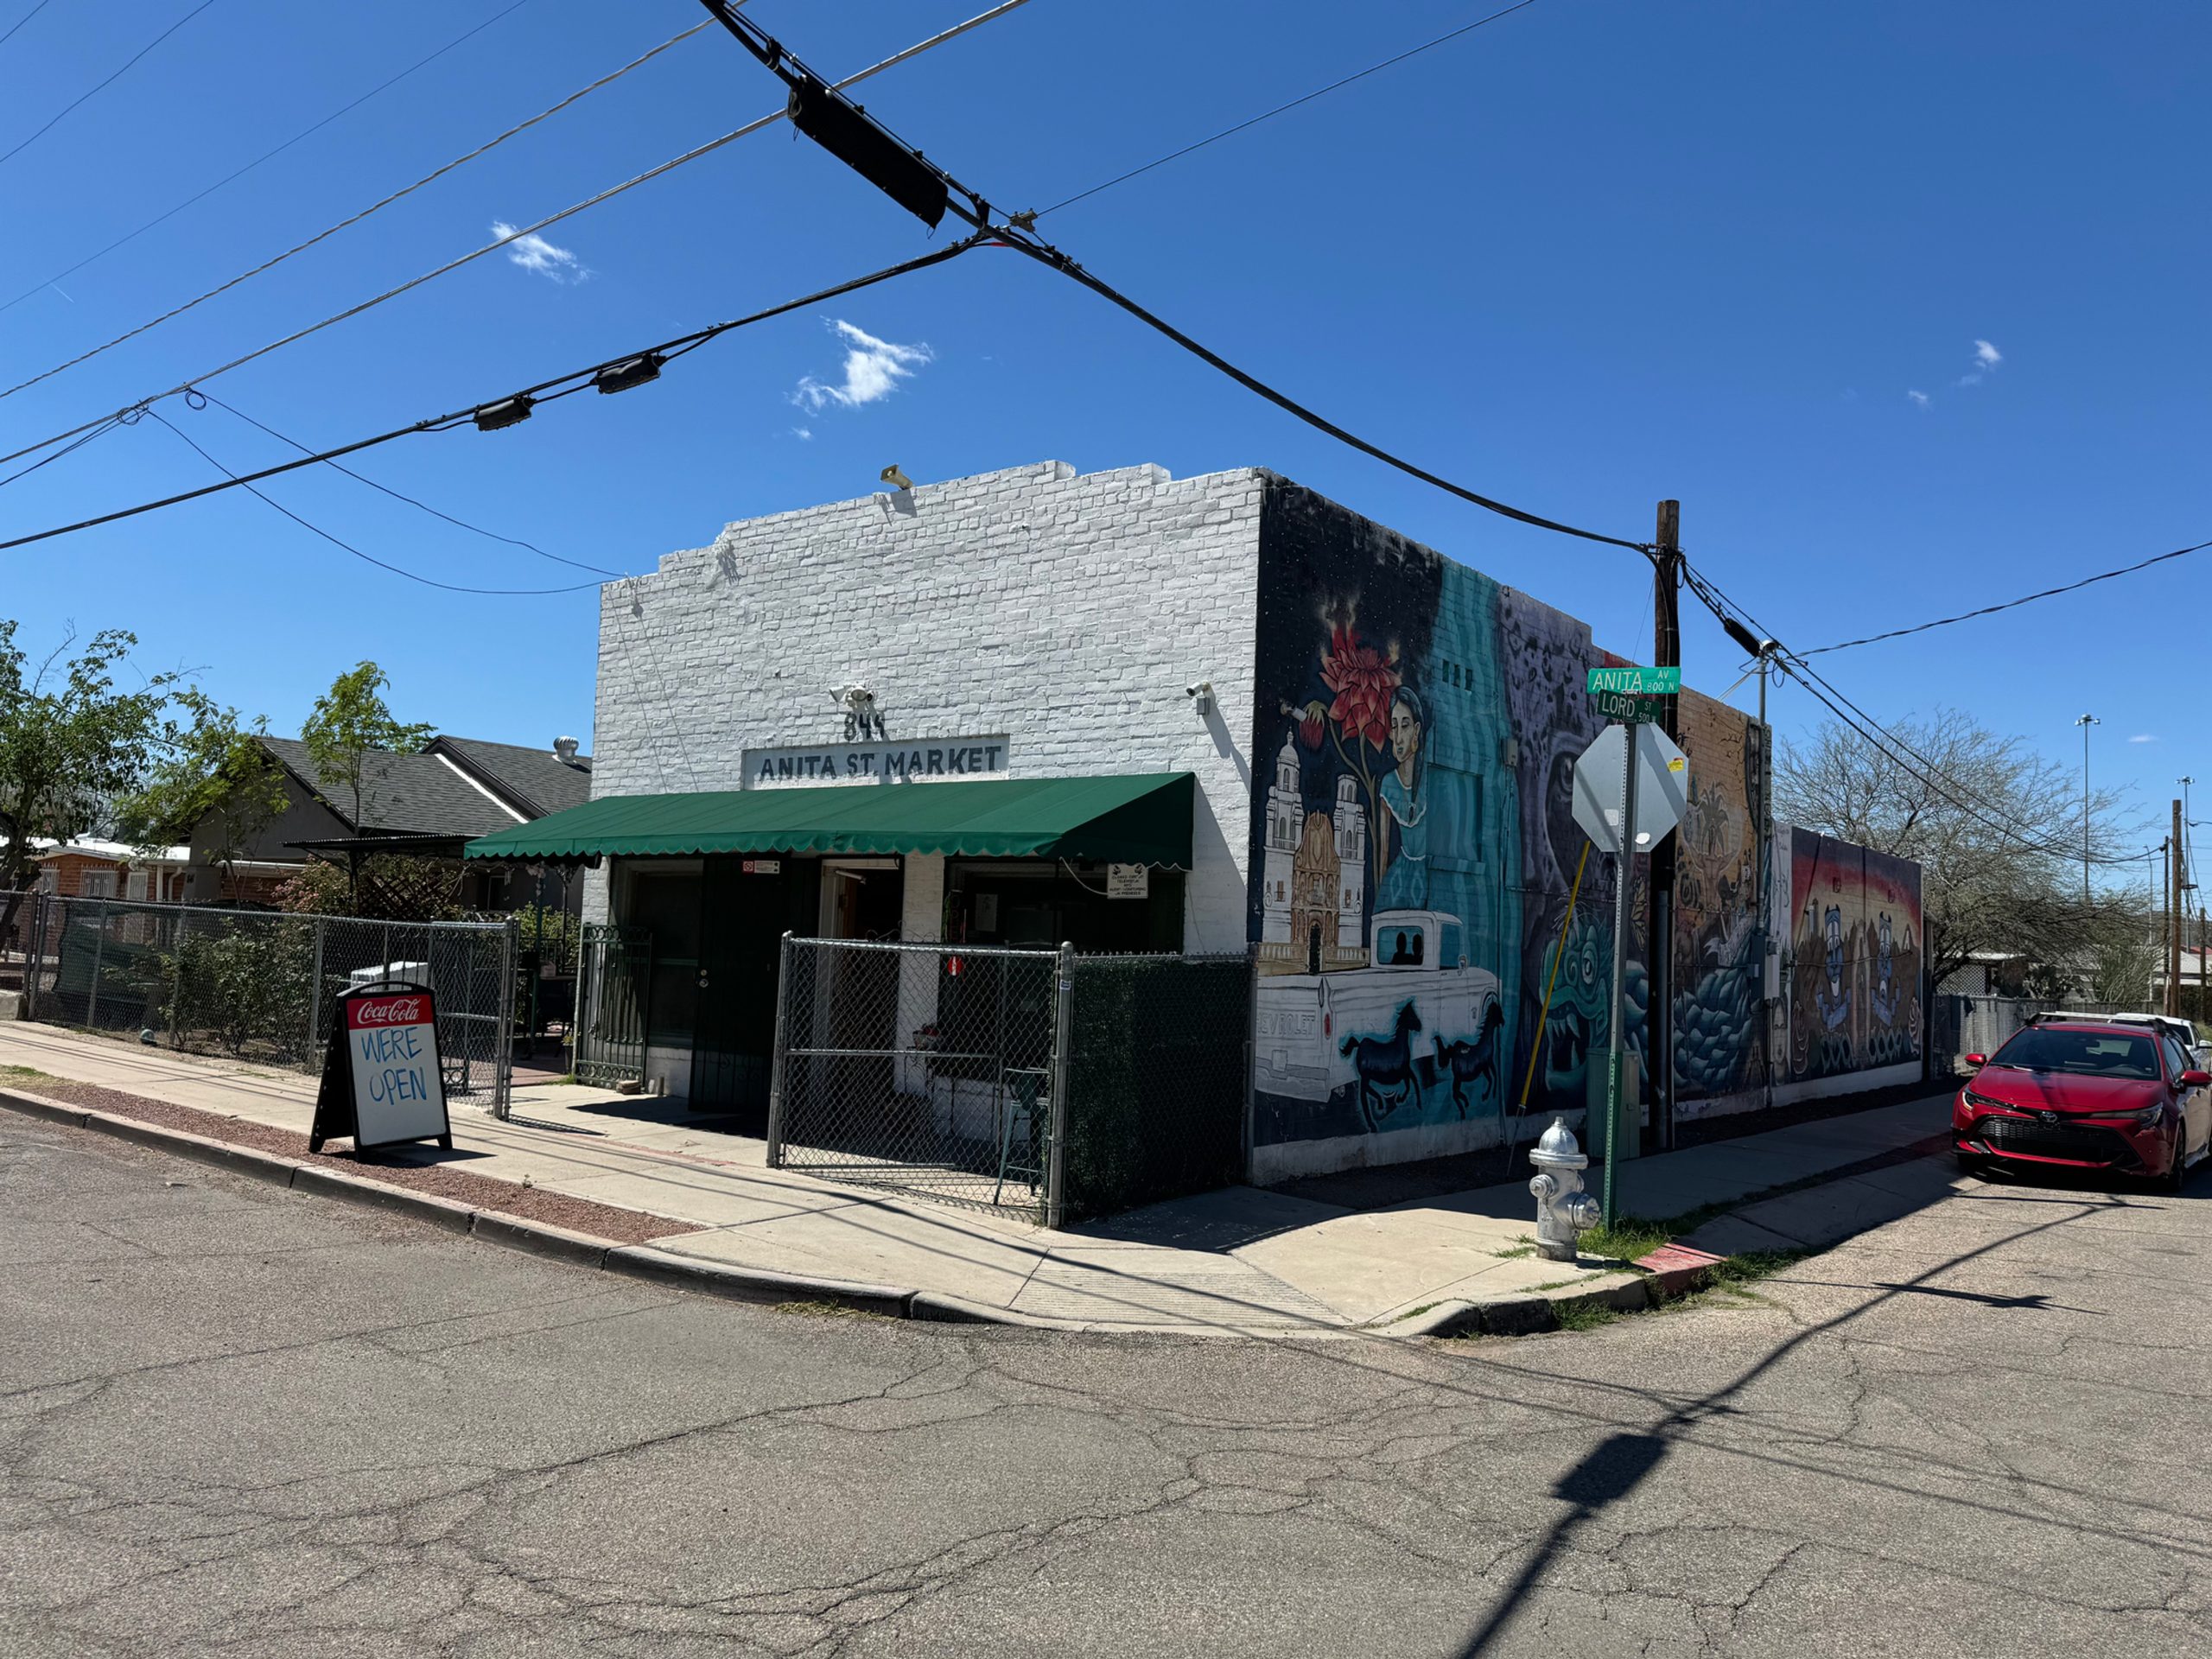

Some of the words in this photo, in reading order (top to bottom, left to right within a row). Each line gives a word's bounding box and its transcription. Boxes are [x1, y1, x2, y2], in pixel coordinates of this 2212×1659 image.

[1592, 671, 1643, 690] ANITA
[1657, 671, 1669, 679] AV
[1647, 681, 1664, 691] 800
[1669, 681, 1675, 690] N
[1601, 693, 1636, 718] LORD
[1644, 702, 1652, 712] ST
[760, 754, 836, 779] ANITA
[885, 746, 1002, 777] MARKET
[357, 998, 422, 1025] Coca-Cola
[369, 1066, 427, 1105] OPEN
